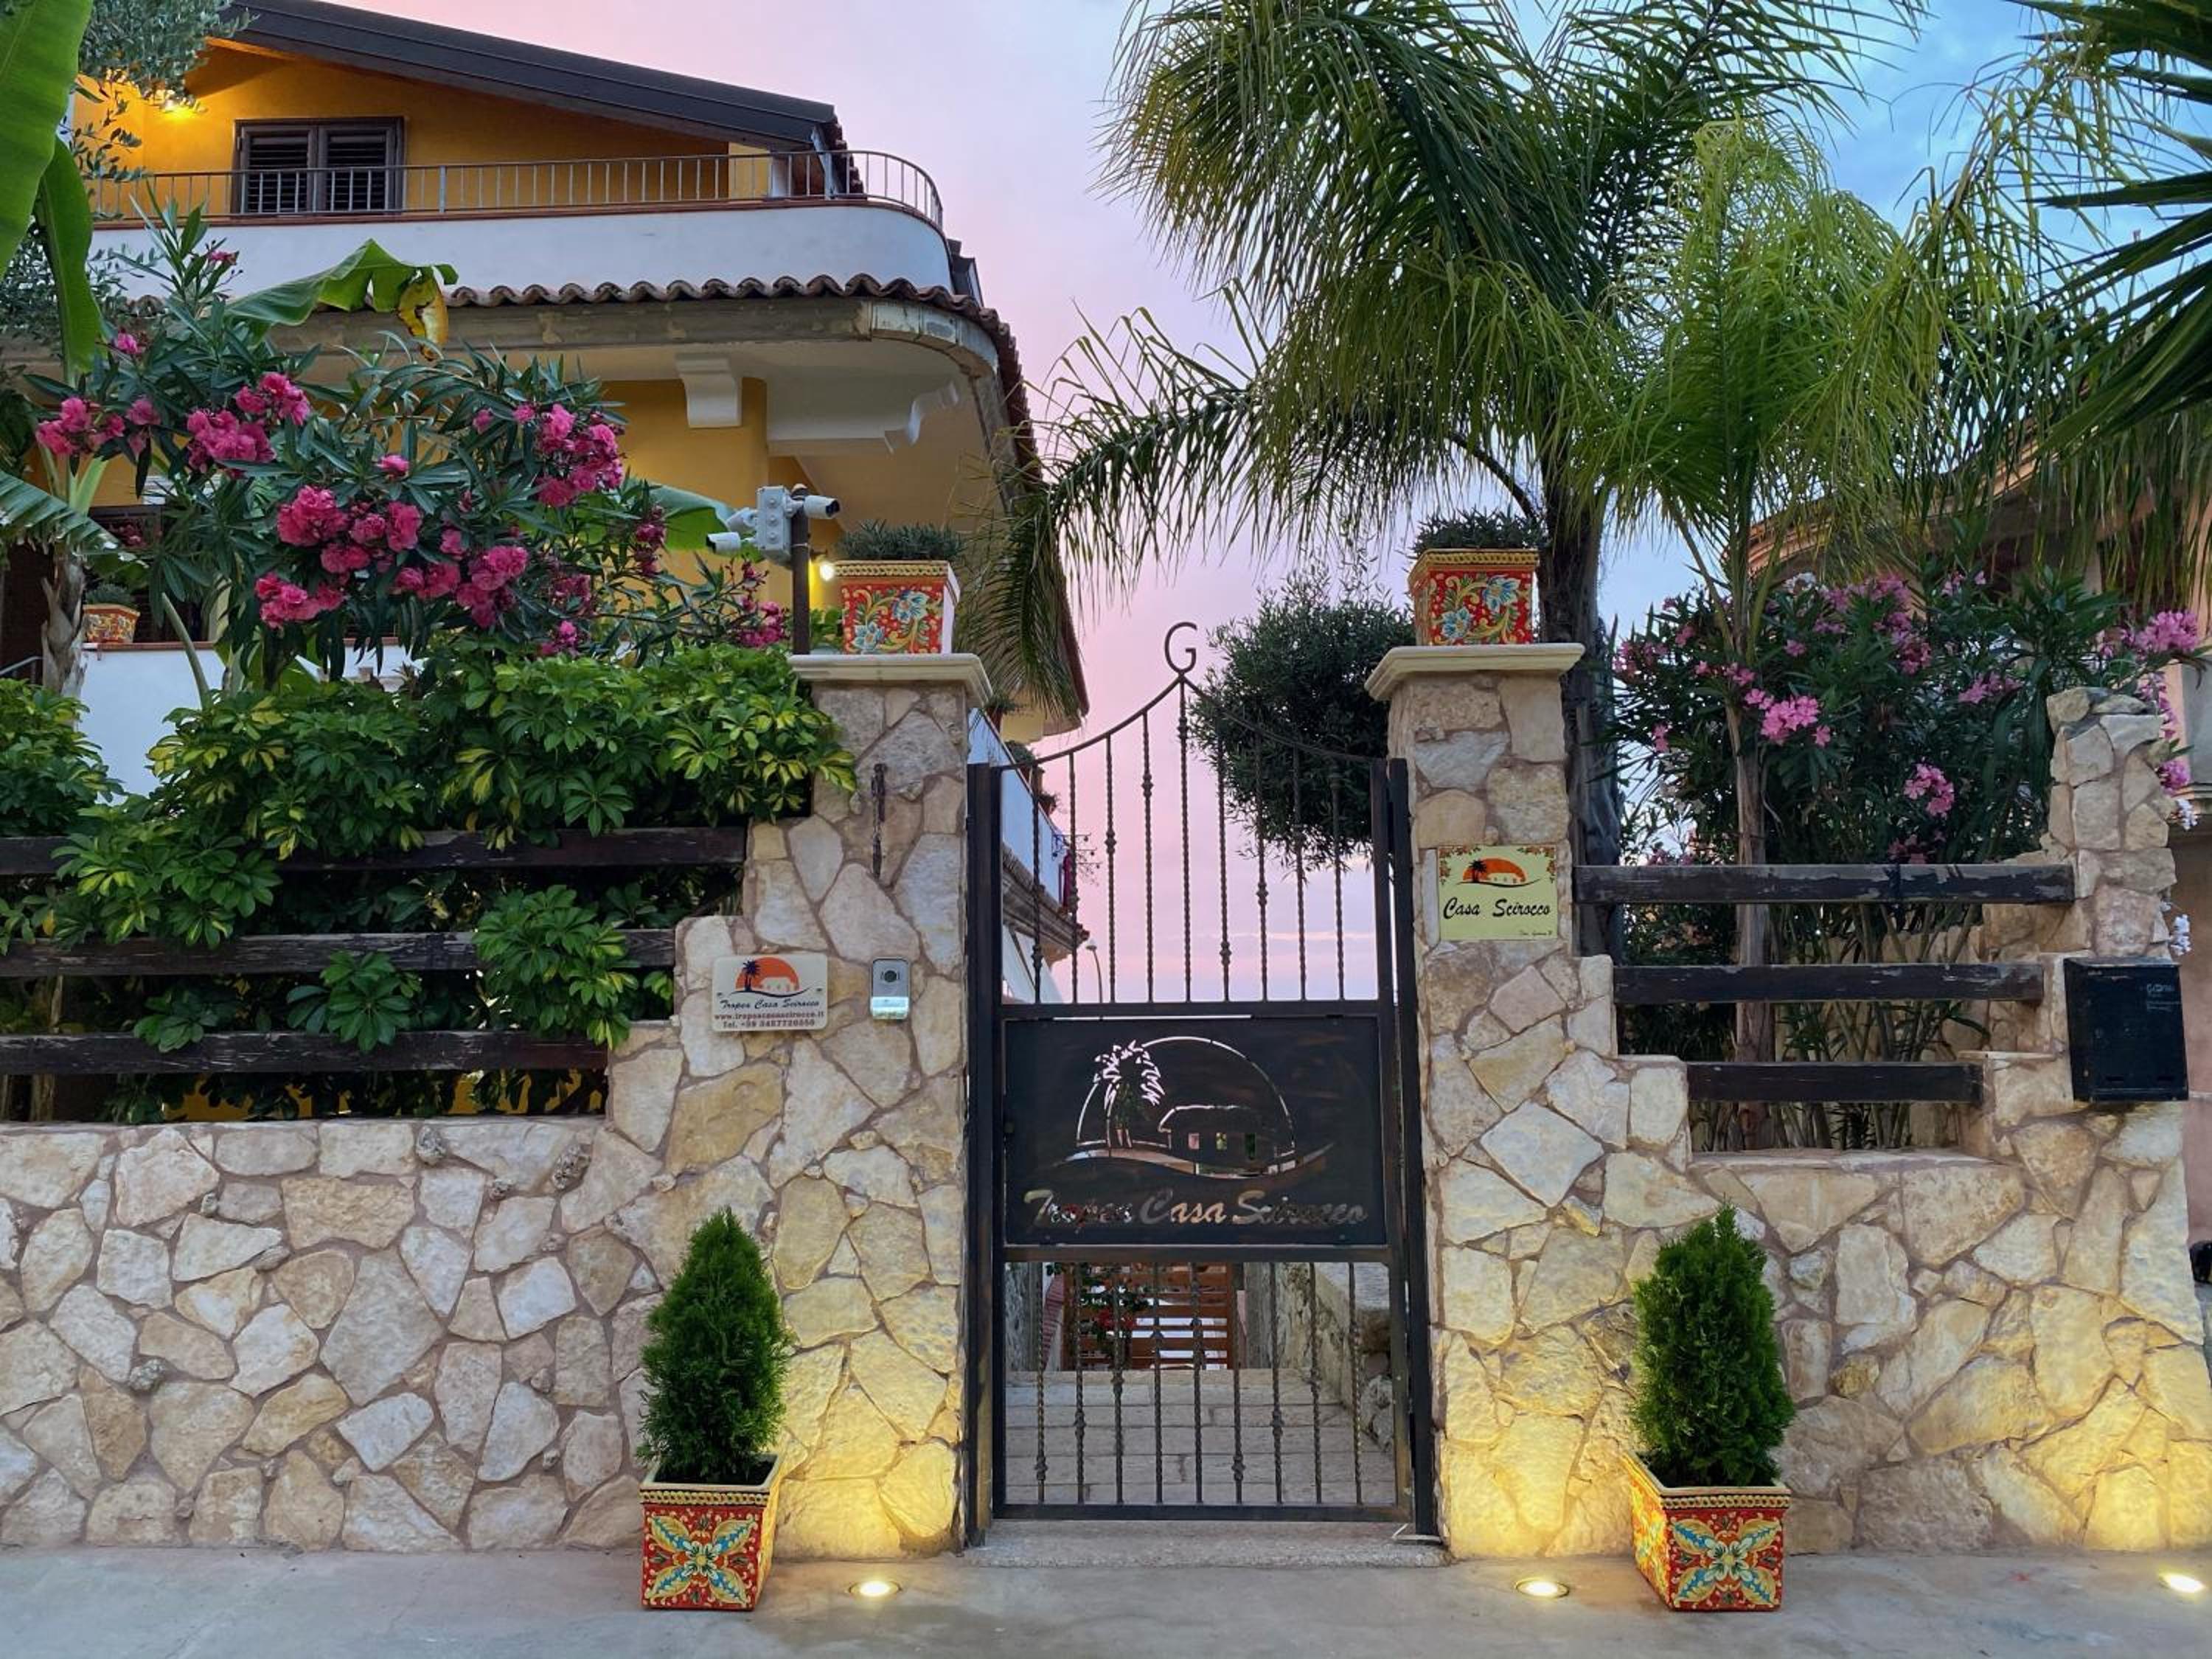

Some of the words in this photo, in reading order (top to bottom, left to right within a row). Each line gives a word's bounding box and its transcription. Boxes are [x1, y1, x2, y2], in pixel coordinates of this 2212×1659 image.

[1443, 897, 1481, 919] Casa
[1492, 899, 1551, 917] Scirocco
[754, 998, 779, 1009] Casa
[782, 998, 820, 1008] Scirocco
[1138, 1188, 1227, 1226] Casa
[1232, 1189, 1369, 1225] Scirocco
